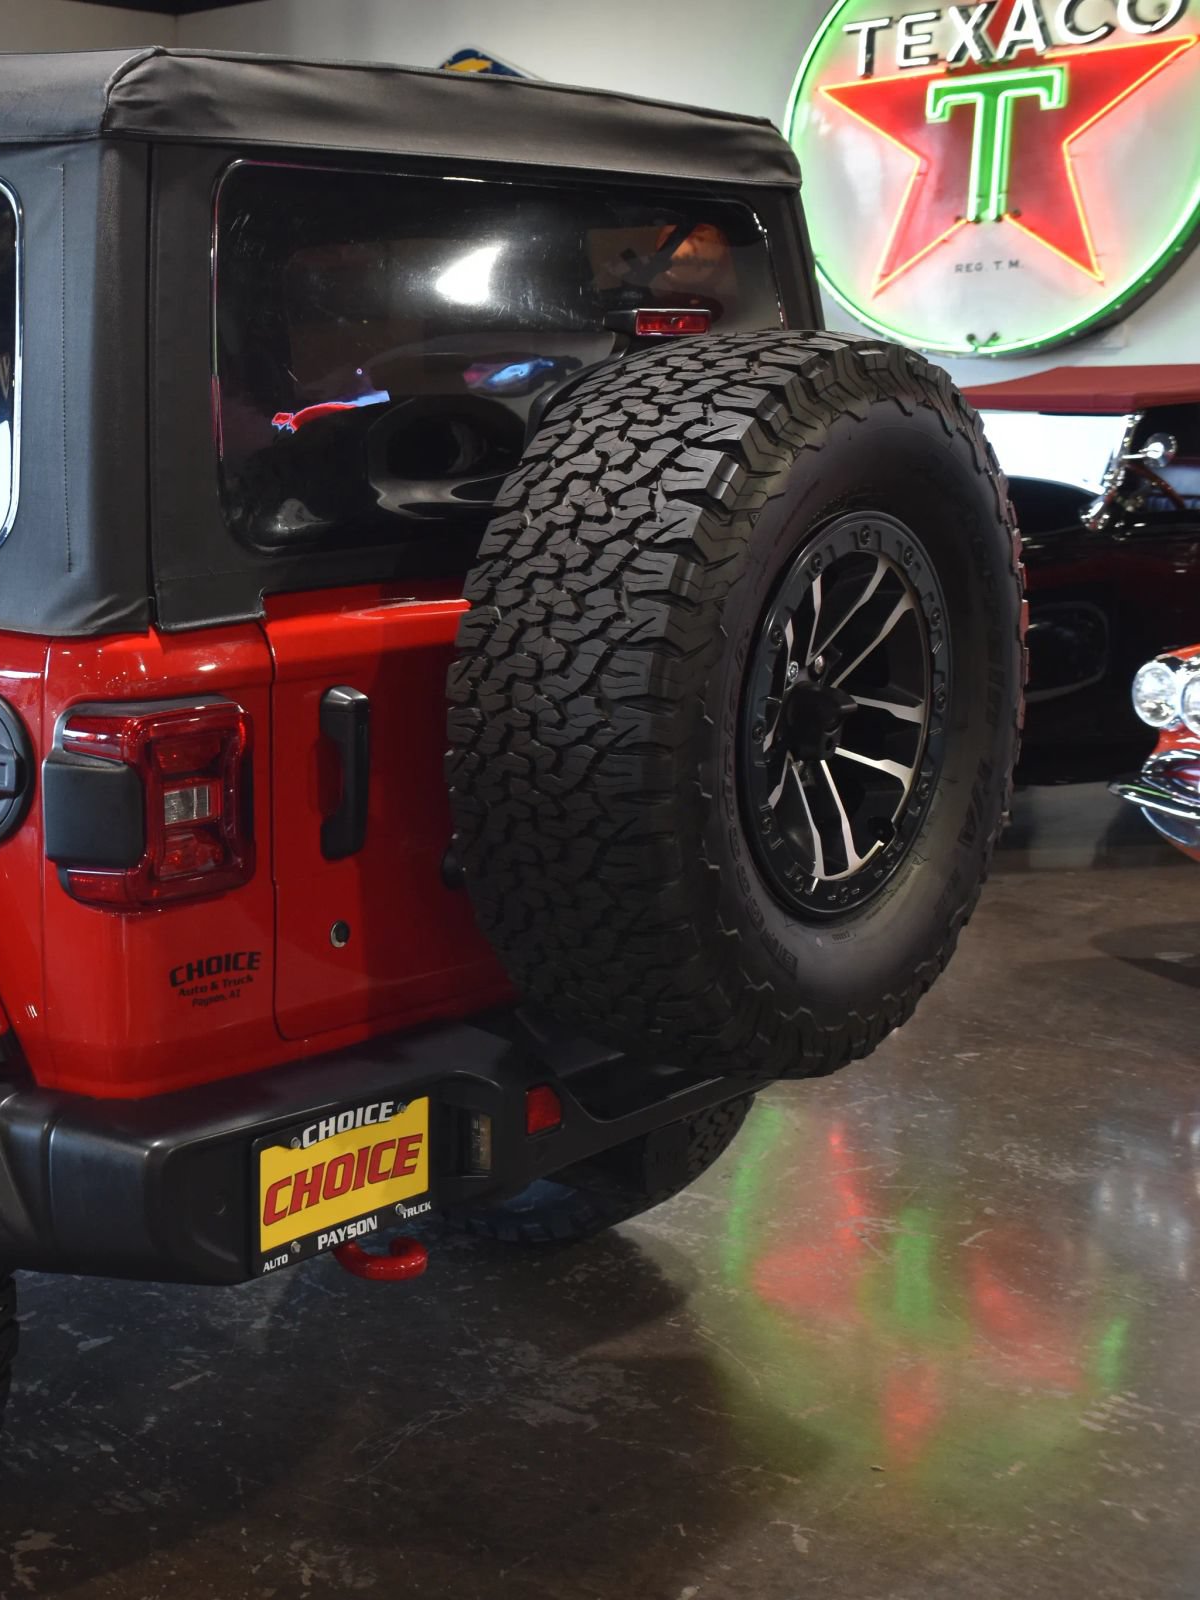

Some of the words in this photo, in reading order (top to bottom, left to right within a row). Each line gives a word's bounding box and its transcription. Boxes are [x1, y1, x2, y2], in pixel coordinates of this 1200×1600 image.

[842, 0, 1188, 77] TEXACO
[925, 62, 1069, 223] T
[169, 951, 262, 988] CHOICE
[179, 985, 208, 997] Auto
[210, 981, 219, 991] &
[222, 974, 254, 989] Truck
[302, 1101, 395, 1148] CHOICE
[263, 1133, 424, 1227] CHOICE
[263, 1254, 289, 1273] AUTO
[318, 1216, 378, 1251] PAYSON
[401, 1201, 432, 1219] TRUCK
